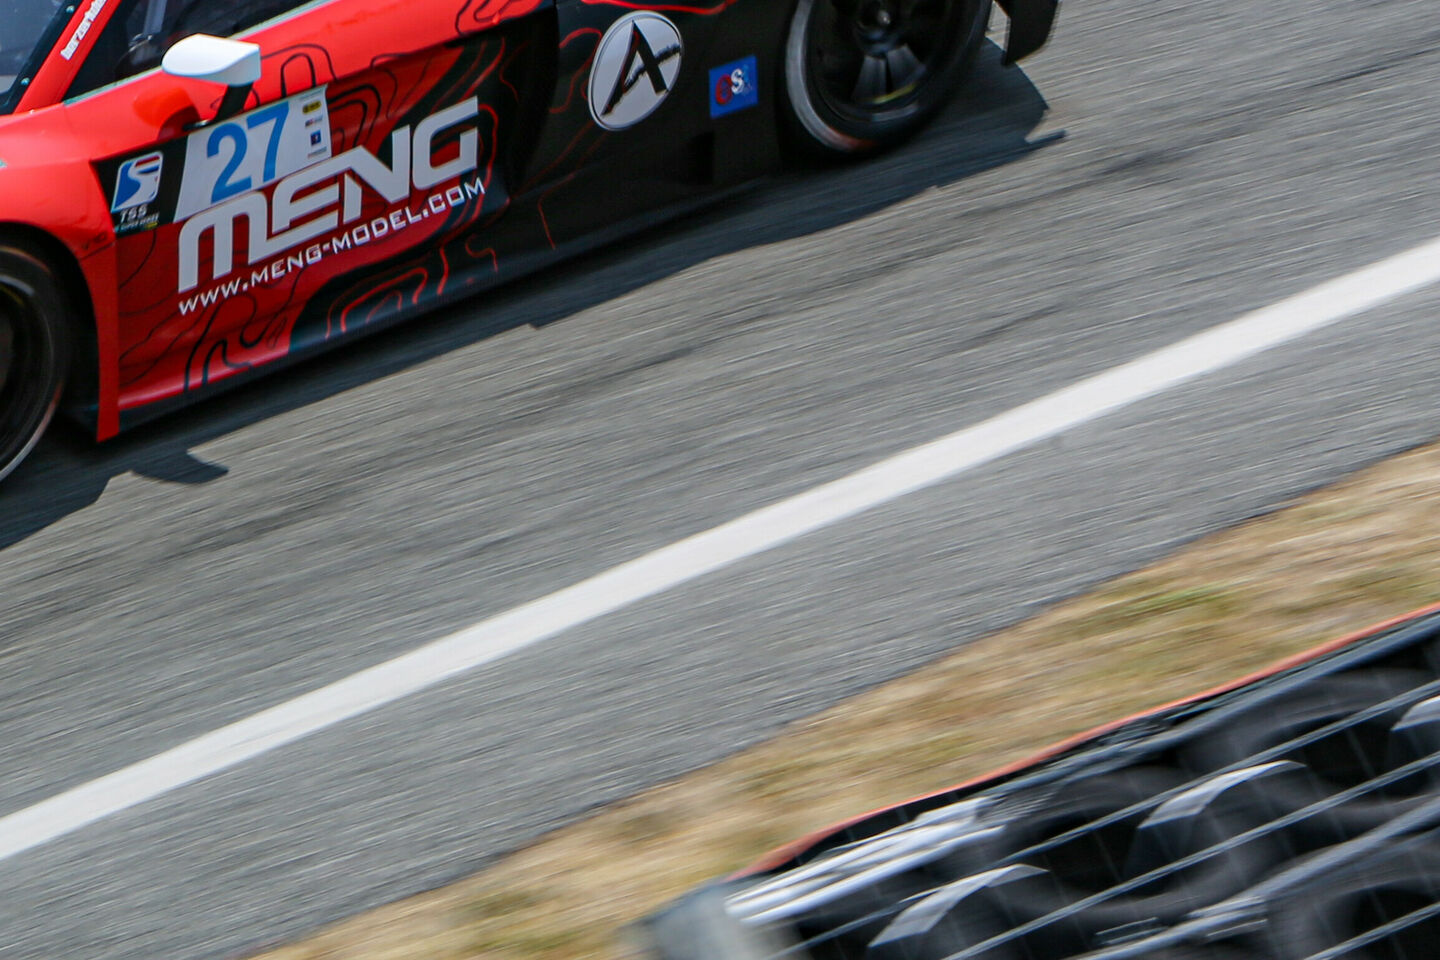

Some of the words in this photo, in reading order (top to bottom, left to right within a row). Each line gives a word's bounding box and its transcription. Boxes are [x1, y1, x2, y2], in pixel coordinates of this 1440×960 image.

[178, 95, 479, 294] MENG
[207, 100, 290, 205] 27
[119, 203, 148, 224] TSS
